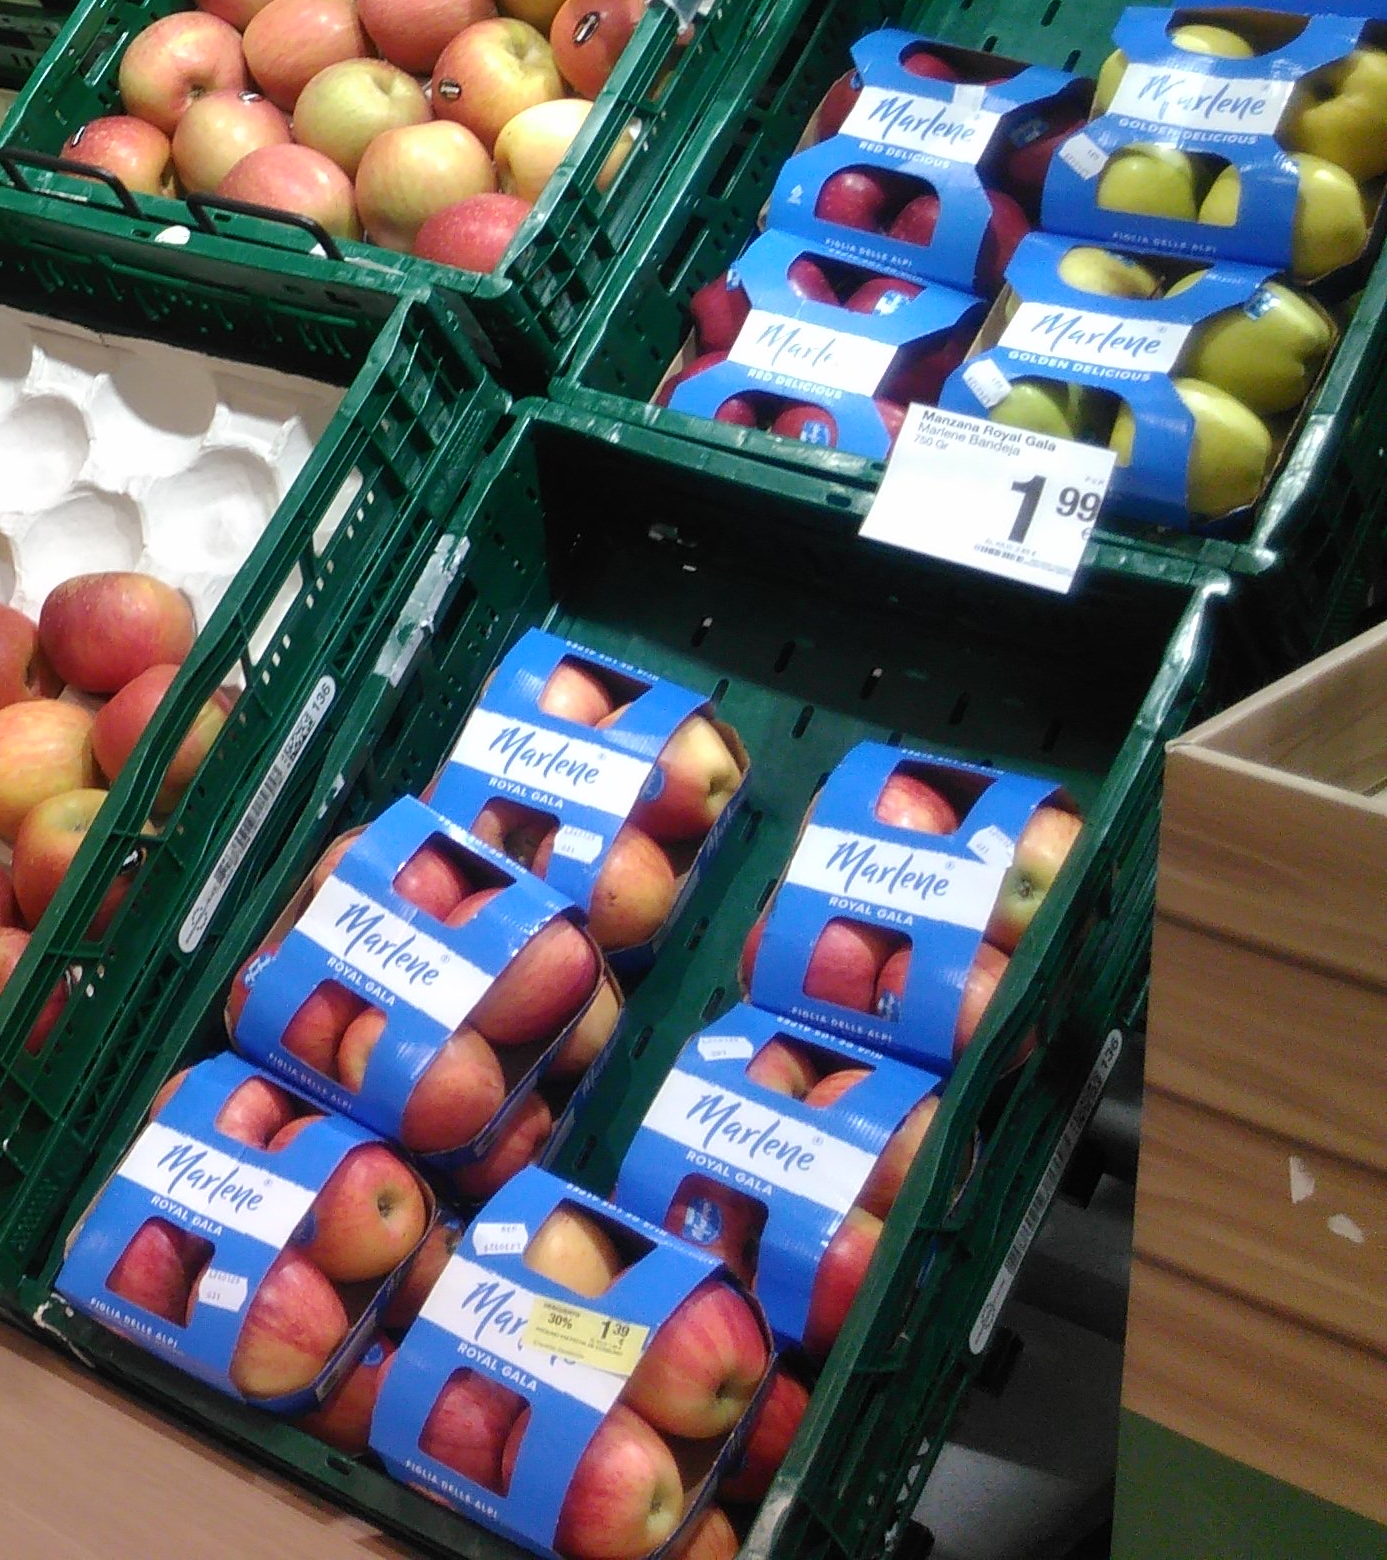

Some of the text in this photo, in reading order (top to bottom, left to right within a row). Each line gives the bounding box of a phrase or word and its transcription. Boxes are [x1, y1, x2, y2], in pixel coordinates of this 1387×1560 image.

[869, 95, 979, 144] Marlene
[1119, 117, 1259, 146] GOLDEN DELICIOUS
[858, 140, 950, 170] RED DELICIOUS
[1031, 312, 1162, 359] Marlene
[746, 367, 843, 401] RED DELICIOUS
[1008, 350, 1152, 383] GOLDEN DELICIOUS
[917, 421, 1021, 458] Marlene Bandeja
[921, 410, 1057, 453] Manzana Royal Gala
[1008, 474, 1102, 545] 1 99
[488, 725, 600, 786] Marlene
[488, 776, 564, 811] ROYAL GALA
[826, 840, 950, 901] Marlene
[829, 895, 914, 927] ROYAL GALA
[335, 903, 440, 988] Marlene
[326, 957, 397, 1007] ROYAL GALA
[686, 1092, 815, 1172] Marlene
[157, 1142, 264, 1213] Marlene
[685, 1149, 774, 1197] ROYAL GALA
[151, 1194, 223, 1237] ROYAL GALA
[90, 1296, 179, 1349] FIGLIA DELLE ALPI
[547, 1313, 630, 1340] 30% 1 39
[457, 1342, 499, 1372] ROYAL
[501, 1363, 538, 1393] GALA
[405, 1458, 499, 1520] FIGLIA DELLE ALPI
